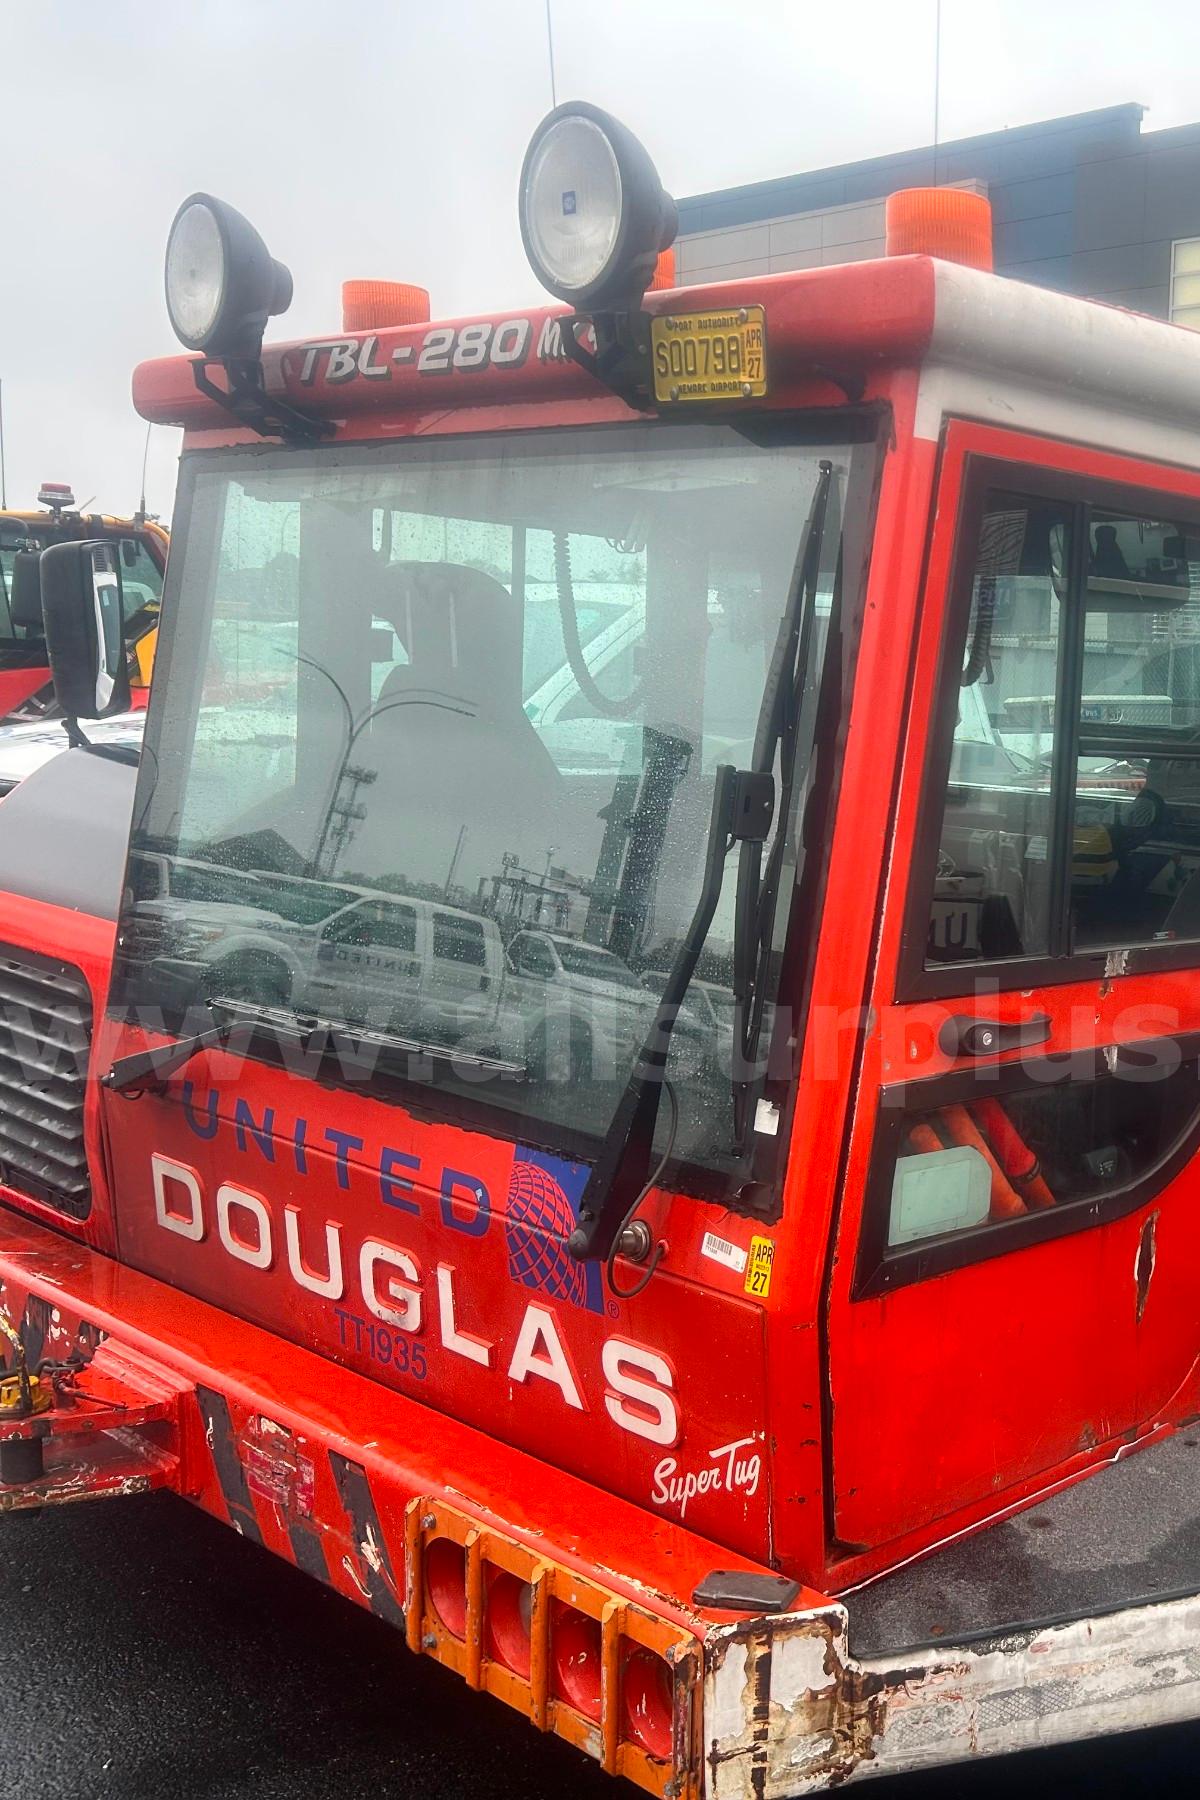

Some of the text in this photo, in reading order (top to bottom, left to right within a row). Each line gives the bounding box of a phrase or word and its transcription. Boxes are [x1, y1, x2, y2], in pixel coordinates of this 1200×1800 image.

[673, 320, 692, 331] PORT
[746, 328, 762, 348] APR
[300, 318, 530, 383] TBL-280
[656, 335, 741, 377] S00798
[748, 357, 761, 378] 27
[183, 1081, 490, 1238] UNITED
[755, 1243, 773, 1264] APR
[151, 1152, 682, 1447] DOUGLAS
[752, 1271, 768, 1293] 27
[334, 1308, 428, 1380] TT1935
[651, 1437, 761, 1518] Super Tug
